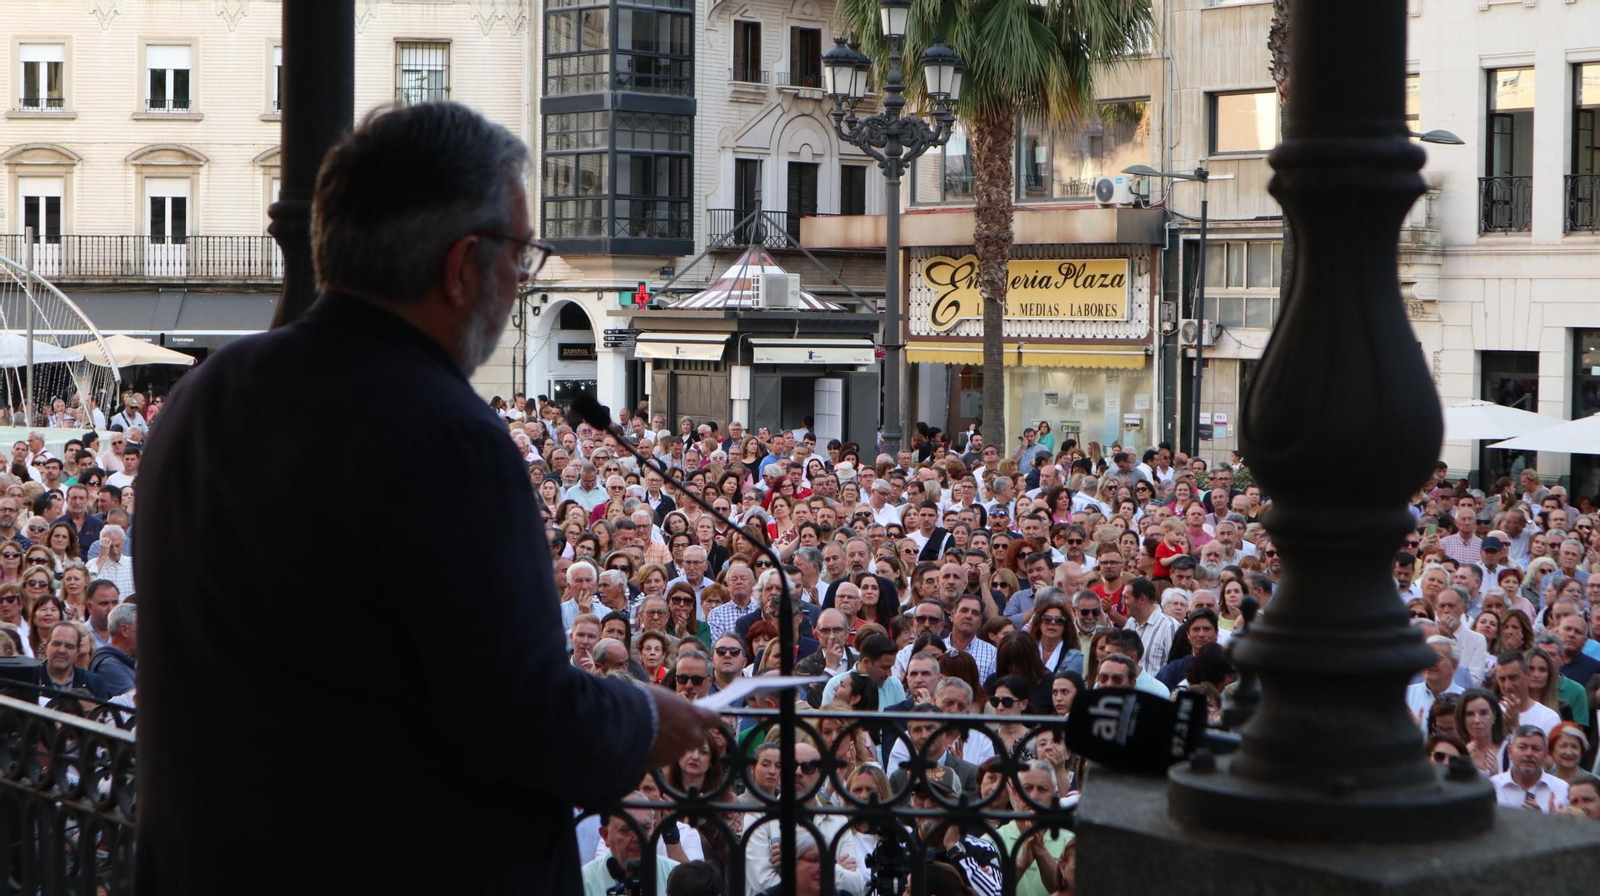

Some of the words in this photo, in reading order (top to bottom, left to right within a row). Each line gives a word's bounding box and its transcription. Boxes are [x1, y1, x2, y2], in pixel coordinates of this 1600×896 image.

[925, 261, 1053, 326] Eneria
[1055, 262, 1126, 290] Plaza
[1020, 303, 1060, 317] MEDIAS
[1070, 303, 1118, 317] LABORES
[1089, 695, 1124, 741] ah
